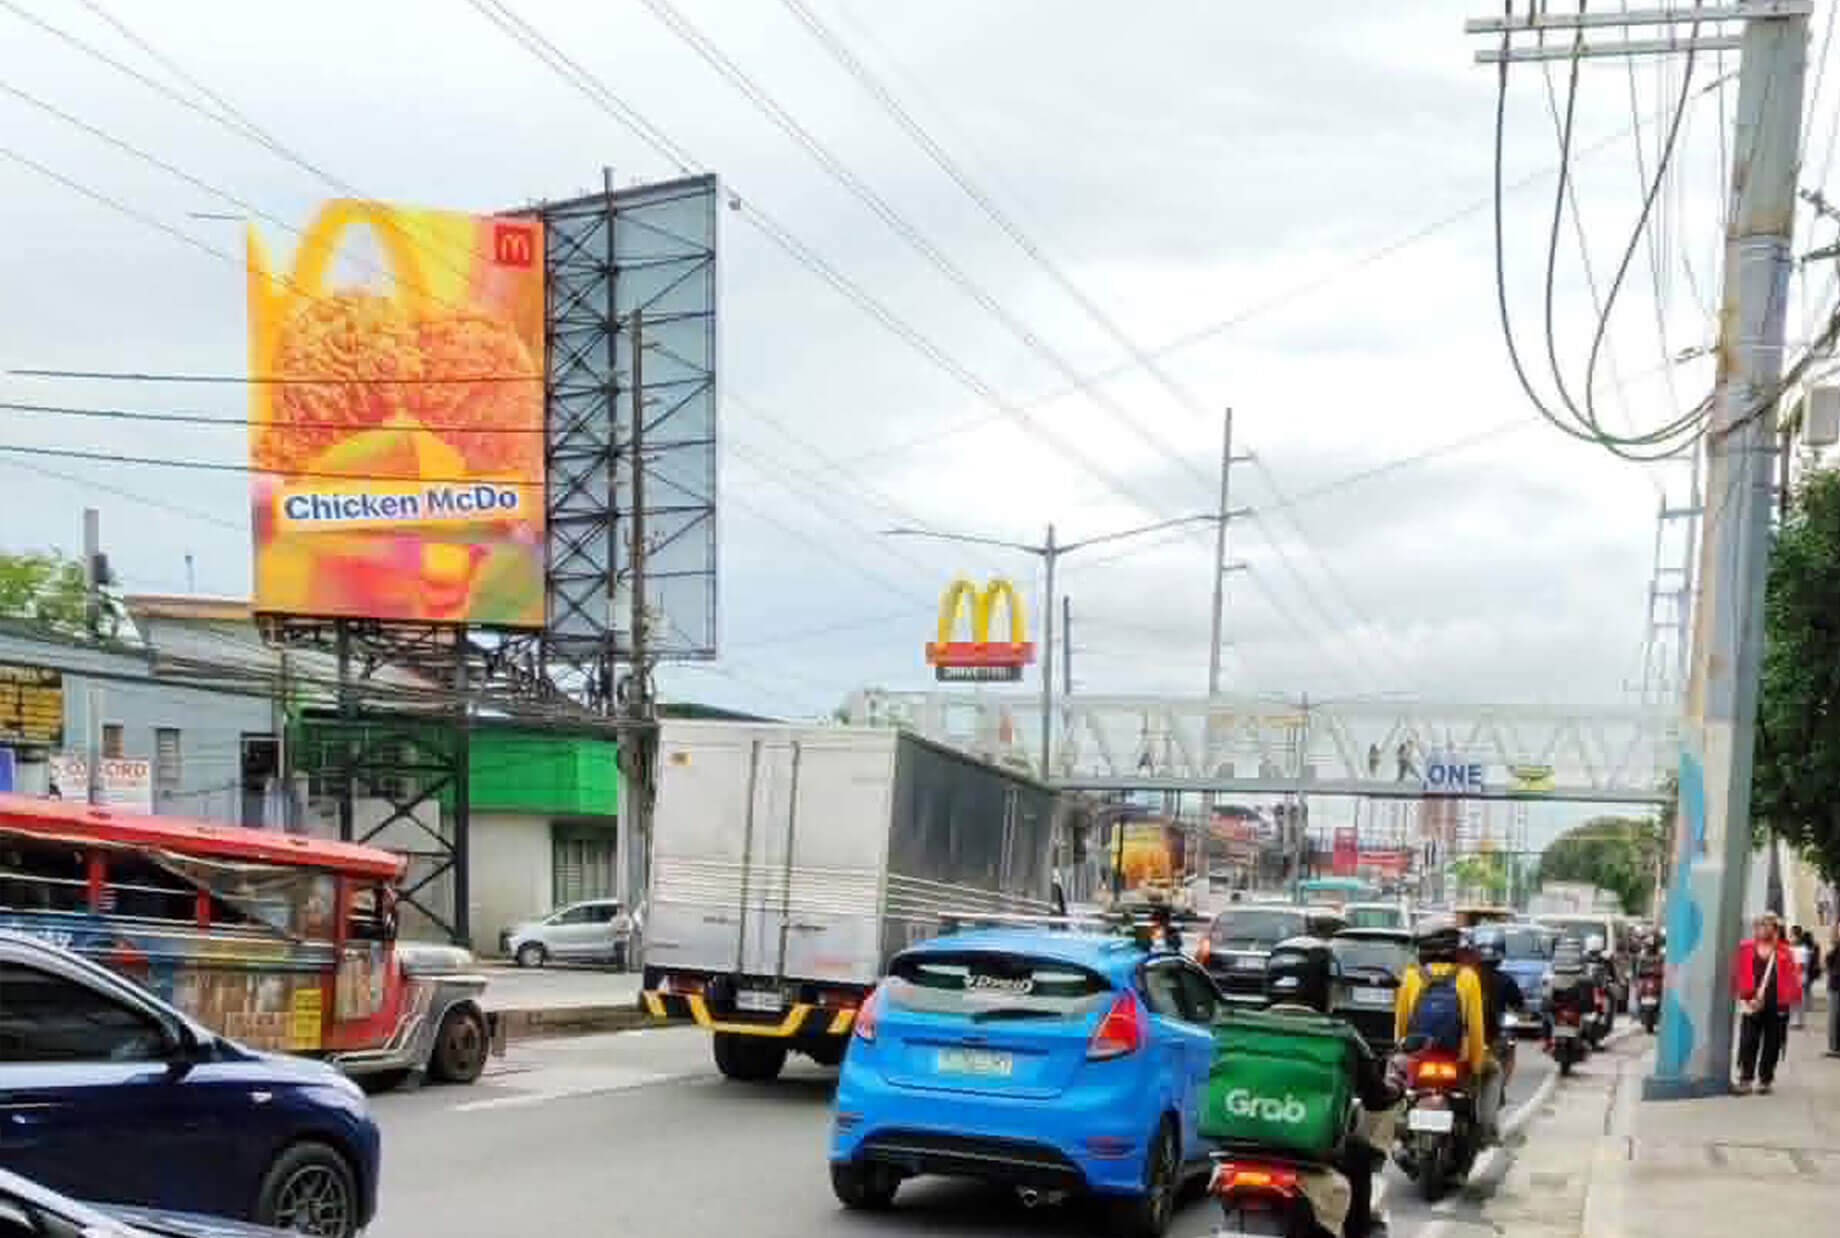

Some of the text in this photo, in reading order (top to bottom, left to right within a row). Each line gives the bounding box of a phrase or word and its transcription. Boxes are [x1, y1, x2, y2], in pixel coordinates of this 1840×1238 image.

[284, 486, 517, 519] Chicken McDo
[1429, 765, 1482, 785] ONE
[1224, 1087, 1307, 1123] Grab
